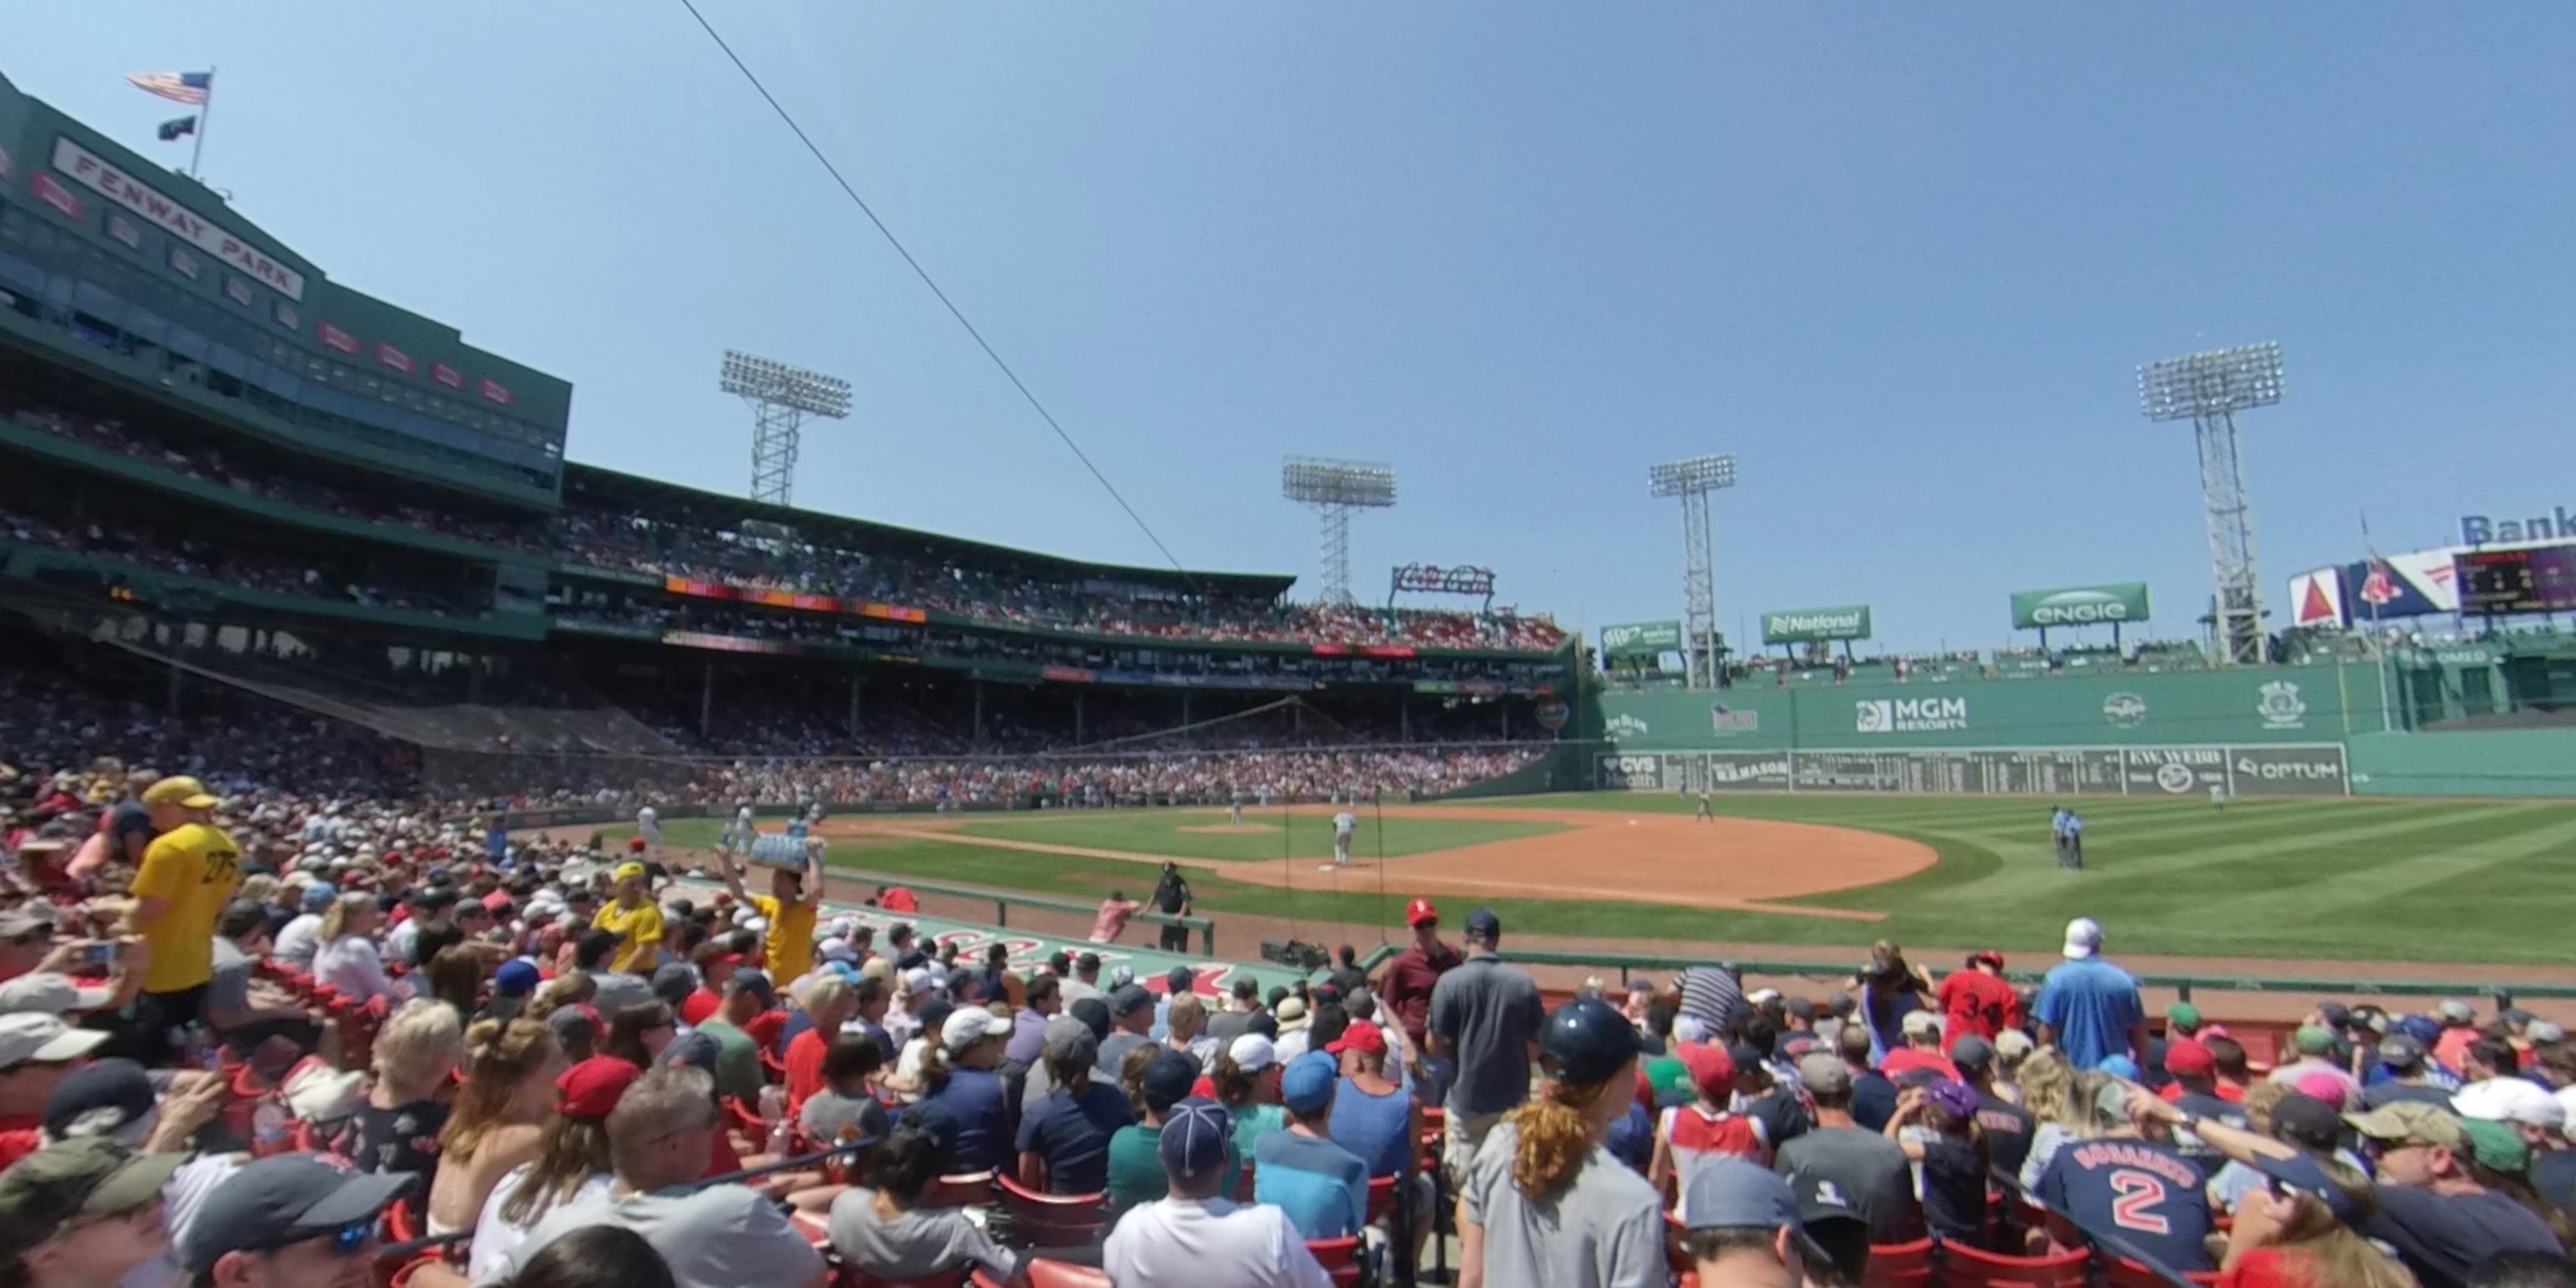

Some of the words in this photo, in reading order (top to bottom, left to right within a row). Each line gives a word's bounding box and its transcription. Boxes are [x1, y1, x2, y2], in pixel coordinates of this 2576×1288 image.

[75, 155, 207, 238] FENWAY
[222, 239, 290, 289] PARK
[2460, 506, 2576, 545] Bank
[1790, 611, 1860, 632] National
[1895, 697, 1967, 719] MGM
[1896, 719, 1967, 732] RESORTS
[1619, 756, 1656, 773] CVS
[2261, 762, 2339, 780] OPTUM
[1605, 772, 1656, 788] Health
[201, 850, 238, 884] 275
[2109, 1169, 2168, 1235] 2
